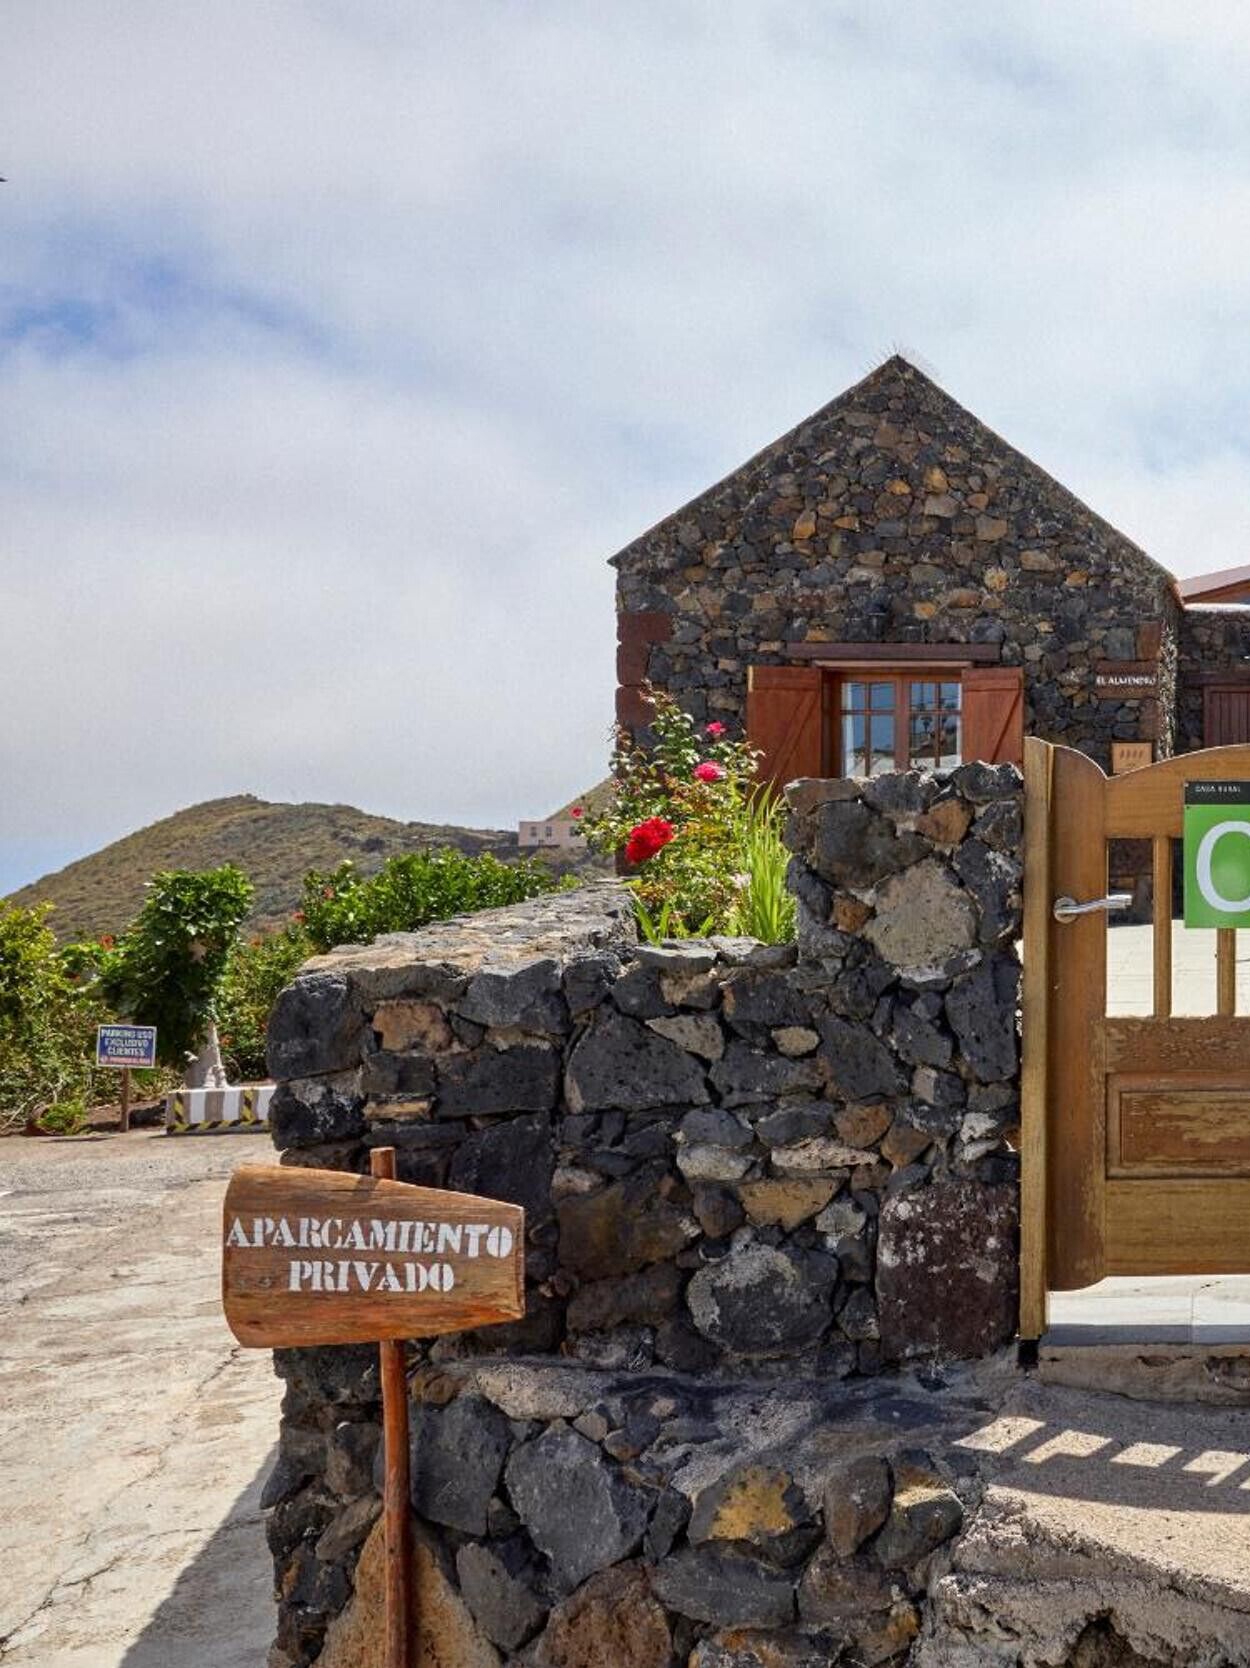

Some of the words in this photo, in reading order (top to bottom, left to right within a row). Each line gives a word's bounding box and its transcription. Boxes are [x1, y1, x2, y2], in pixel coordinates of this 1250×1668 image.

[1096, 675, 1107, 685] EL
[101, 1029, 136, 1038] PARKING
[104, 1038, 149, 1048] EXCLUSIVO
[107, 1046, 146, 1056] CLIENTES
[226, 1216, 513, 1259] APARCAMIENTO
[288, 1260, 455, 1293] PRIVADO
